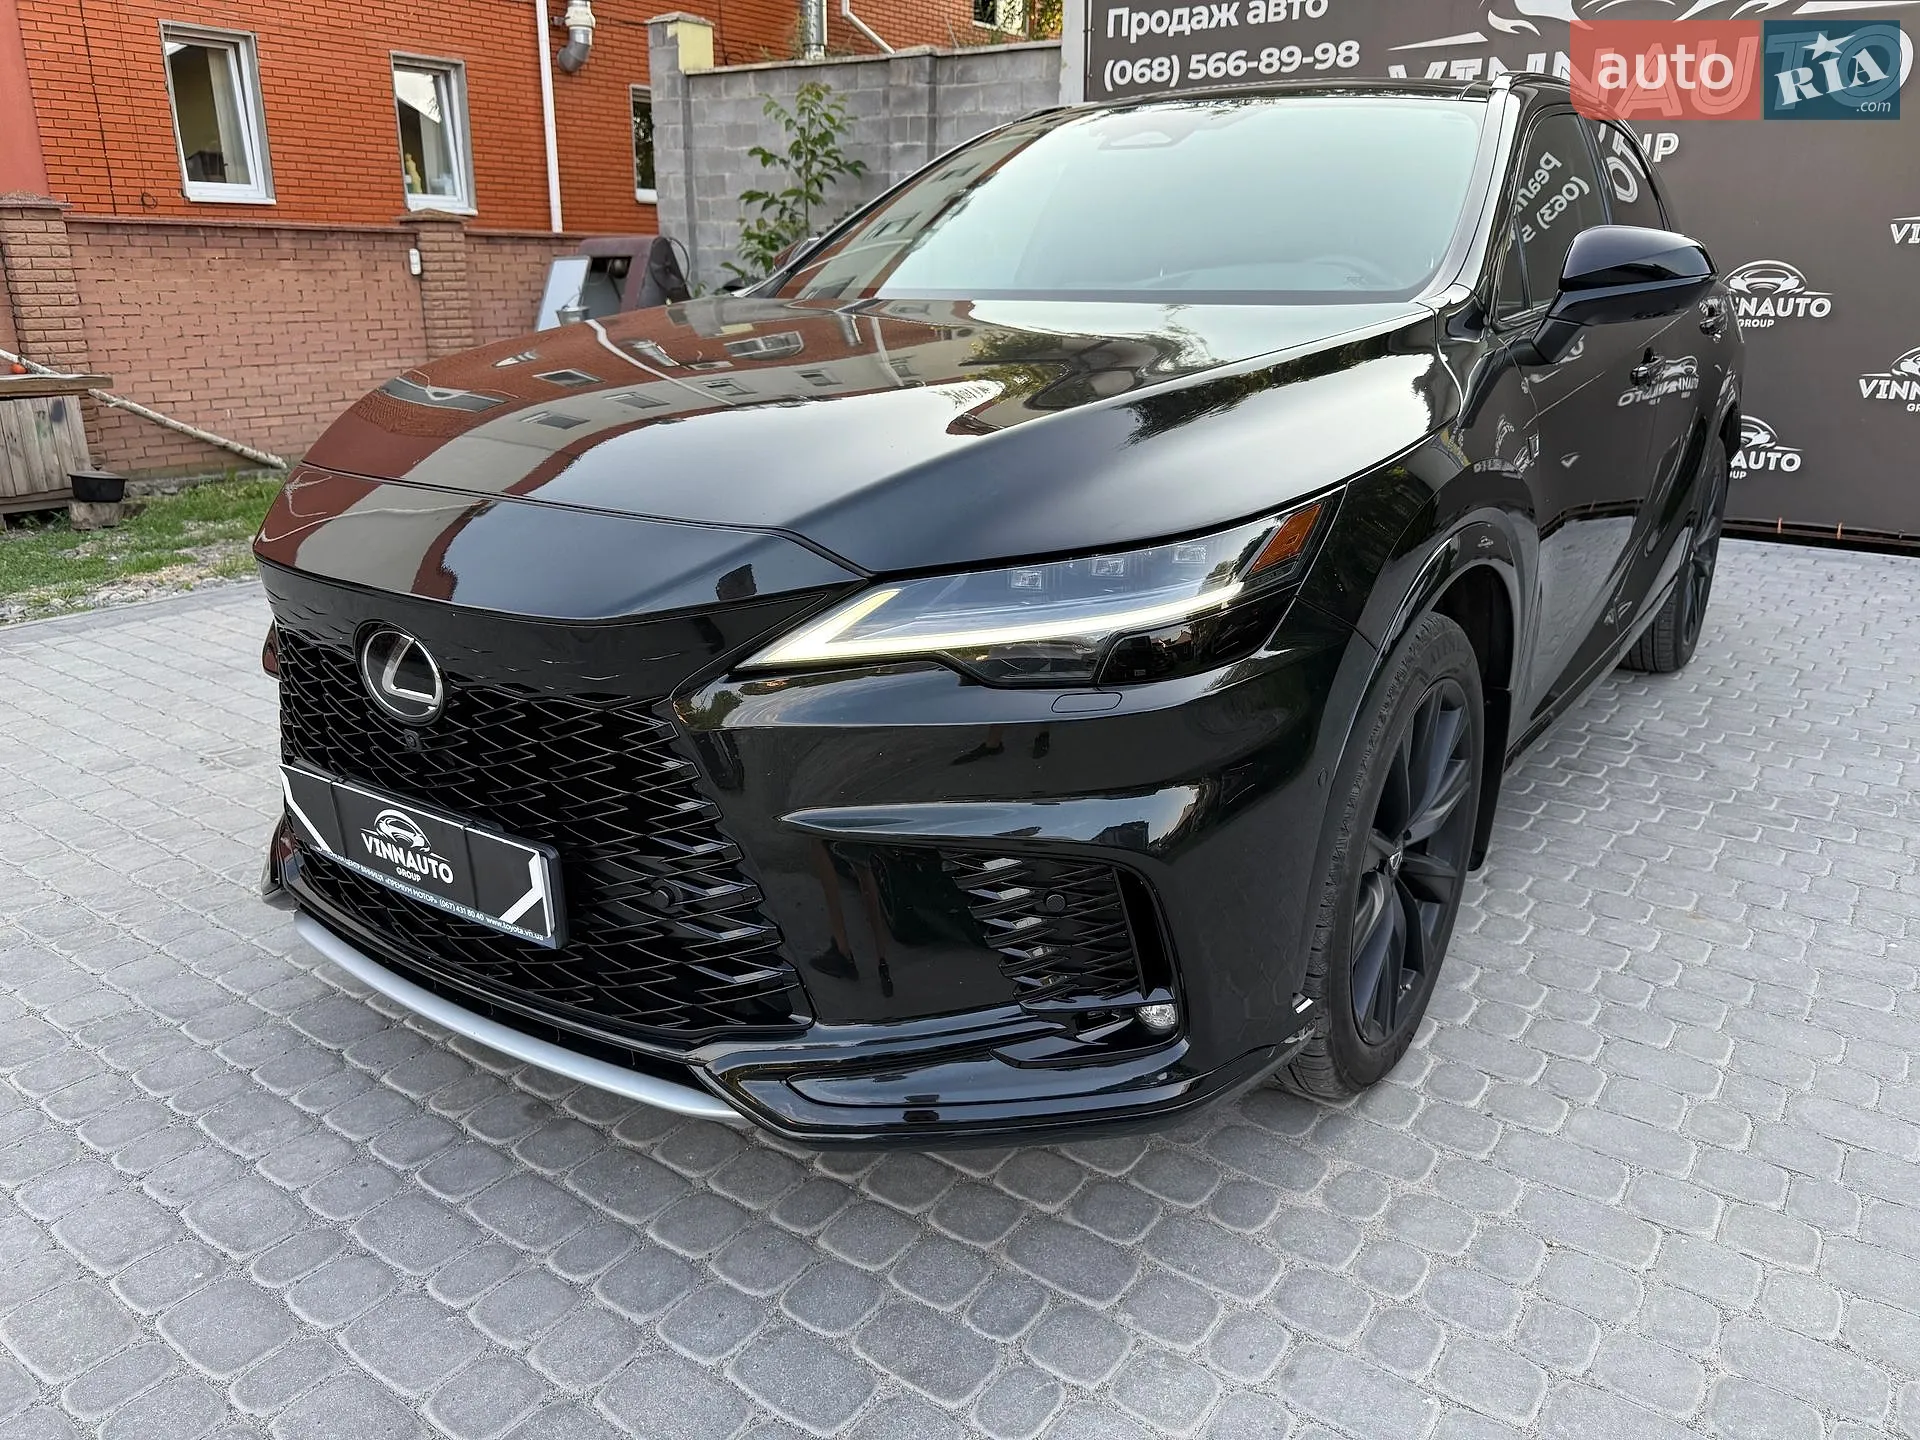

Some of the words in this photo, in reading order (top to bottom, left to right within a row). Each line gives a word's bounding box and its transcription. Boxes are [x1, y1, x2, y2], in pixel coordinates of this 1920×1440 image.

[1107, 2, 1240, 44] Продаж
[1104, 54, 1180, 92] (068)
[1187, 40, 1361, 80] 566-89-98
[1735, 297, 1832, 318] NAUTO
[1730, 450, 1802, 472] AUTO
[361, 832, 454, 884] VINNAUTO
[396, 866, 421, 882] GROUP
